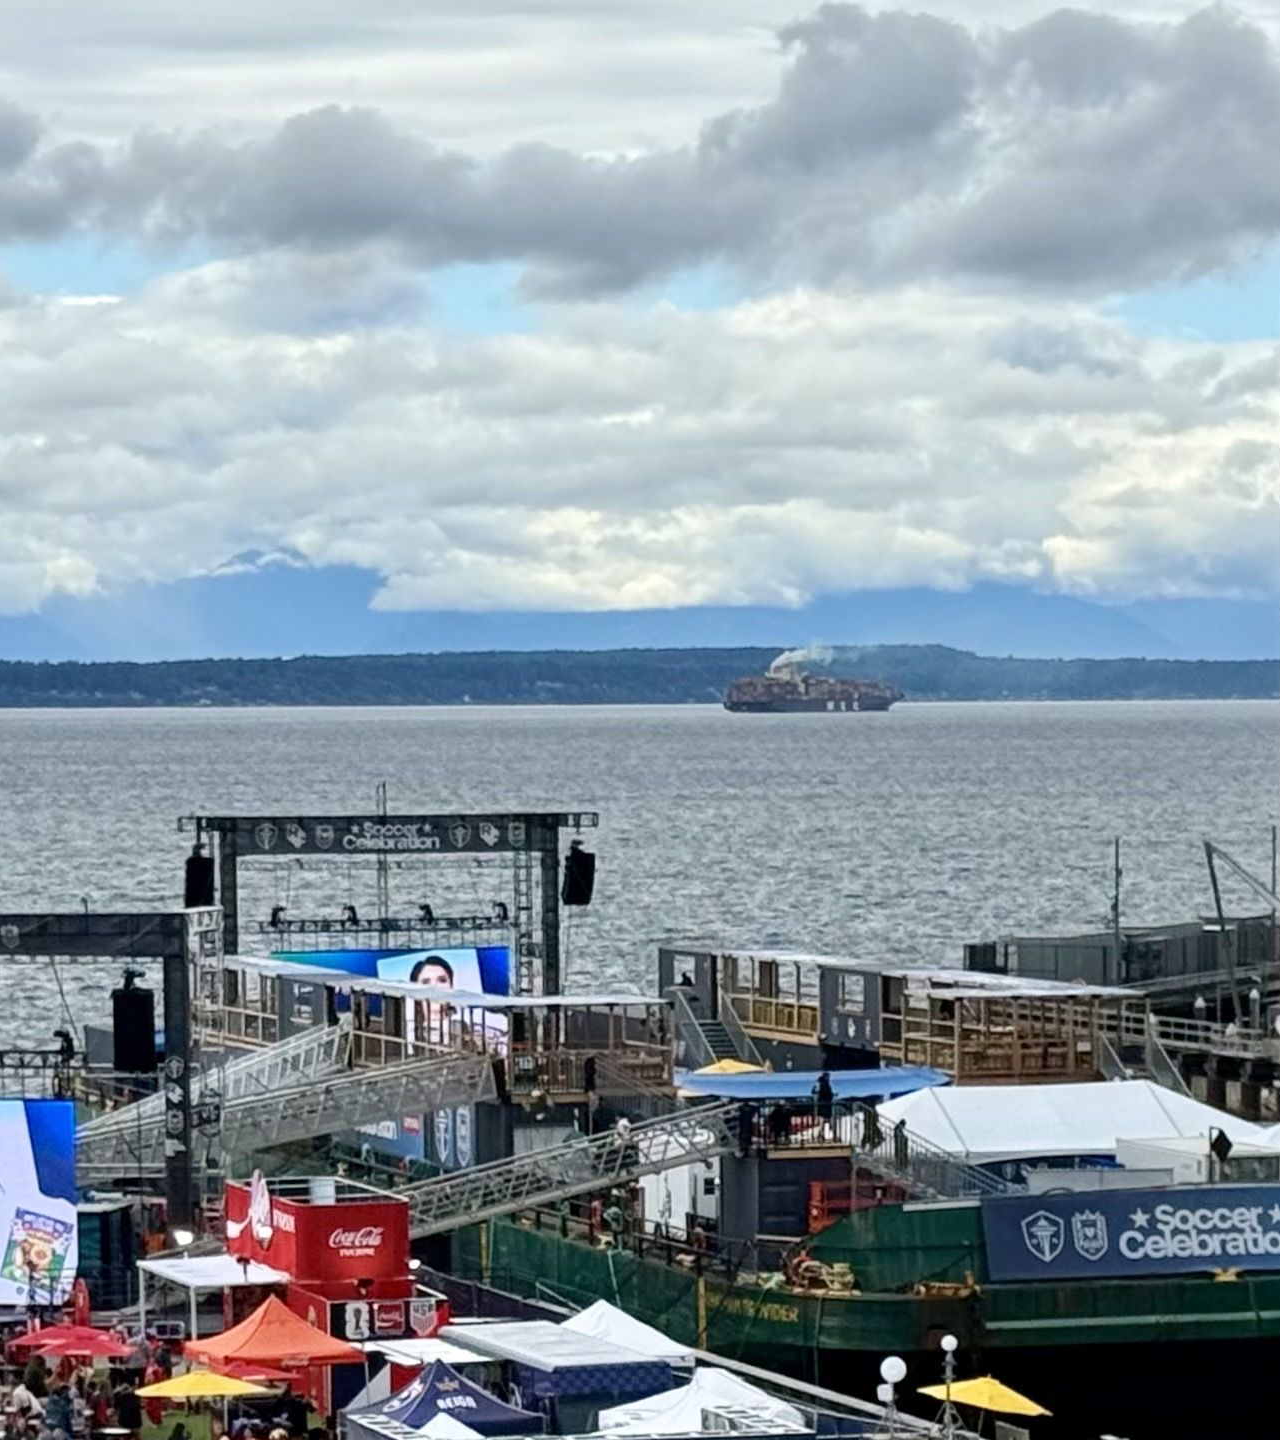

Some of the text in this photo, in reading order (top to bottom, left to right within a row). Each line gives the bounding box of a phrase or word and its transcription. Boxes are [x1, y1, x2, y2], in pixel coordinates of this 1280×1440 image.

[363, 822, 420, 836] Soccer
[343, 833, 441, 849] Celebration
[1154, 1205, 1263, 1231] Soccer
